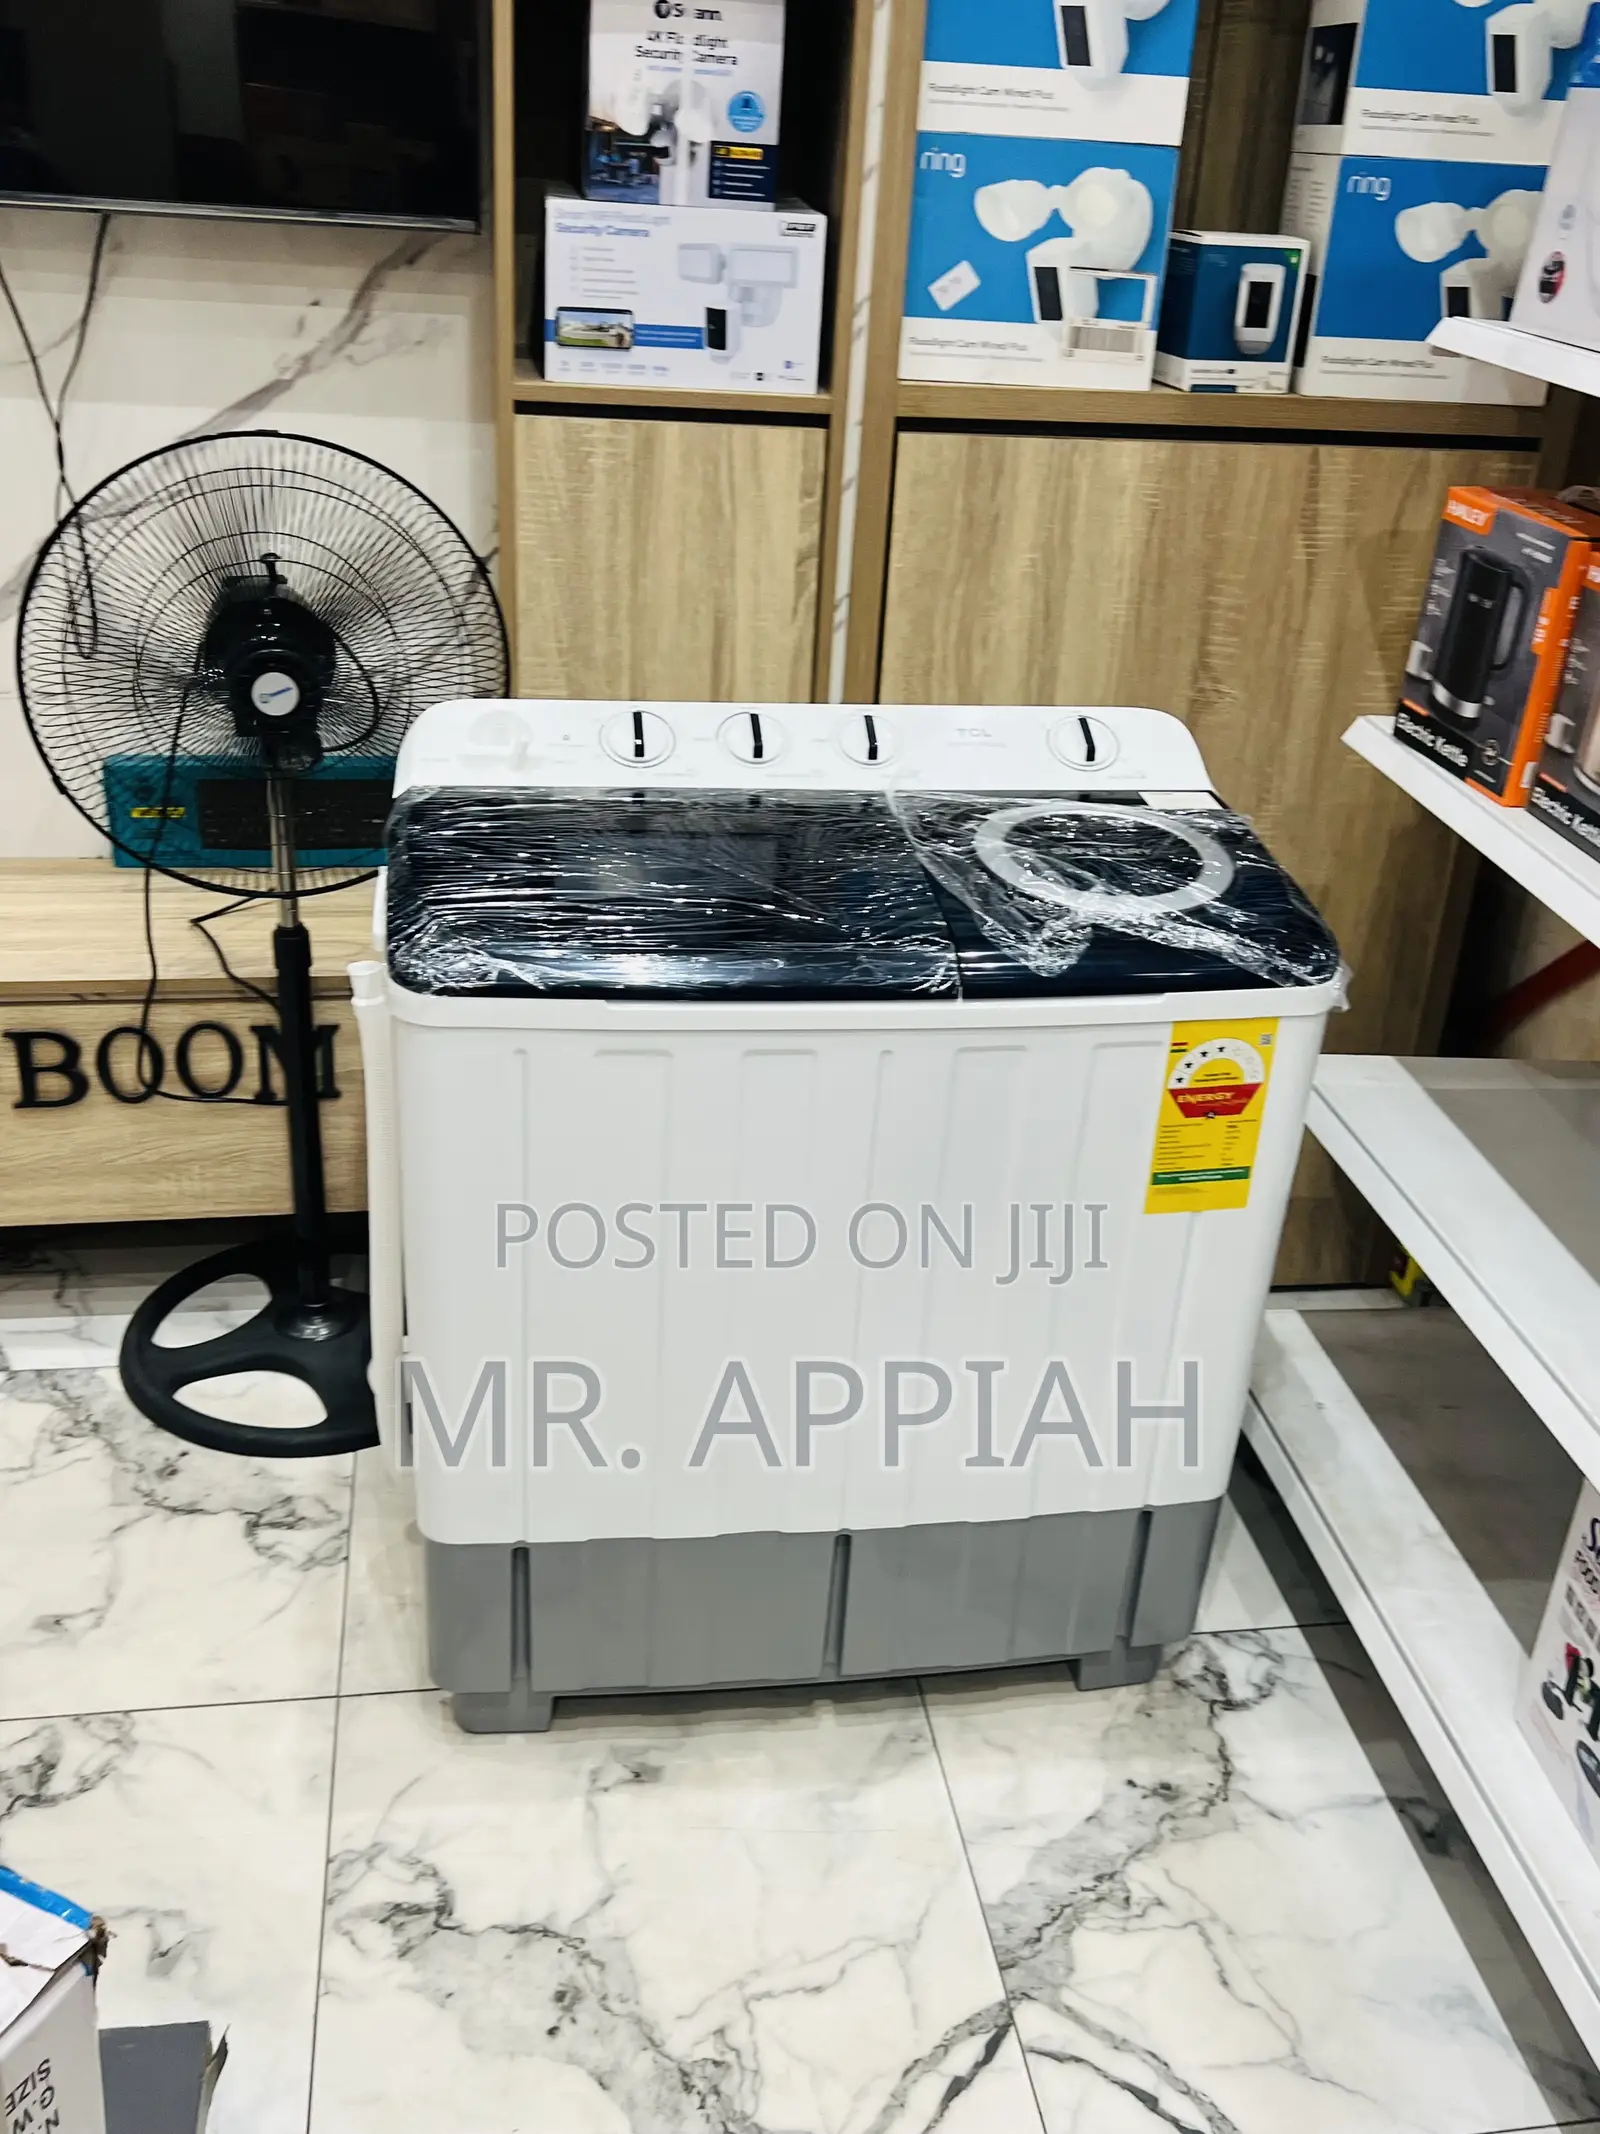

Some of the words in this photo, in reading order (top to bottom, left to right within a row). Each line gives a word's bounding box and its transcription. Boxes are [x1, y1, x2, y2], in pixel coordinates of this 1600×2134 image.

[919, 147, 967, 178] ring
[1346, 172, 1392, 201] ring
[954, 727, 993, 738] TCL
[1396, 712, 1436, 748] Electric
[3, 1021, 341, 1109] BOOM
[1176, 1091, 1237, 1104] ENERGY
[5, 2058, 51, 2117] SIZE
